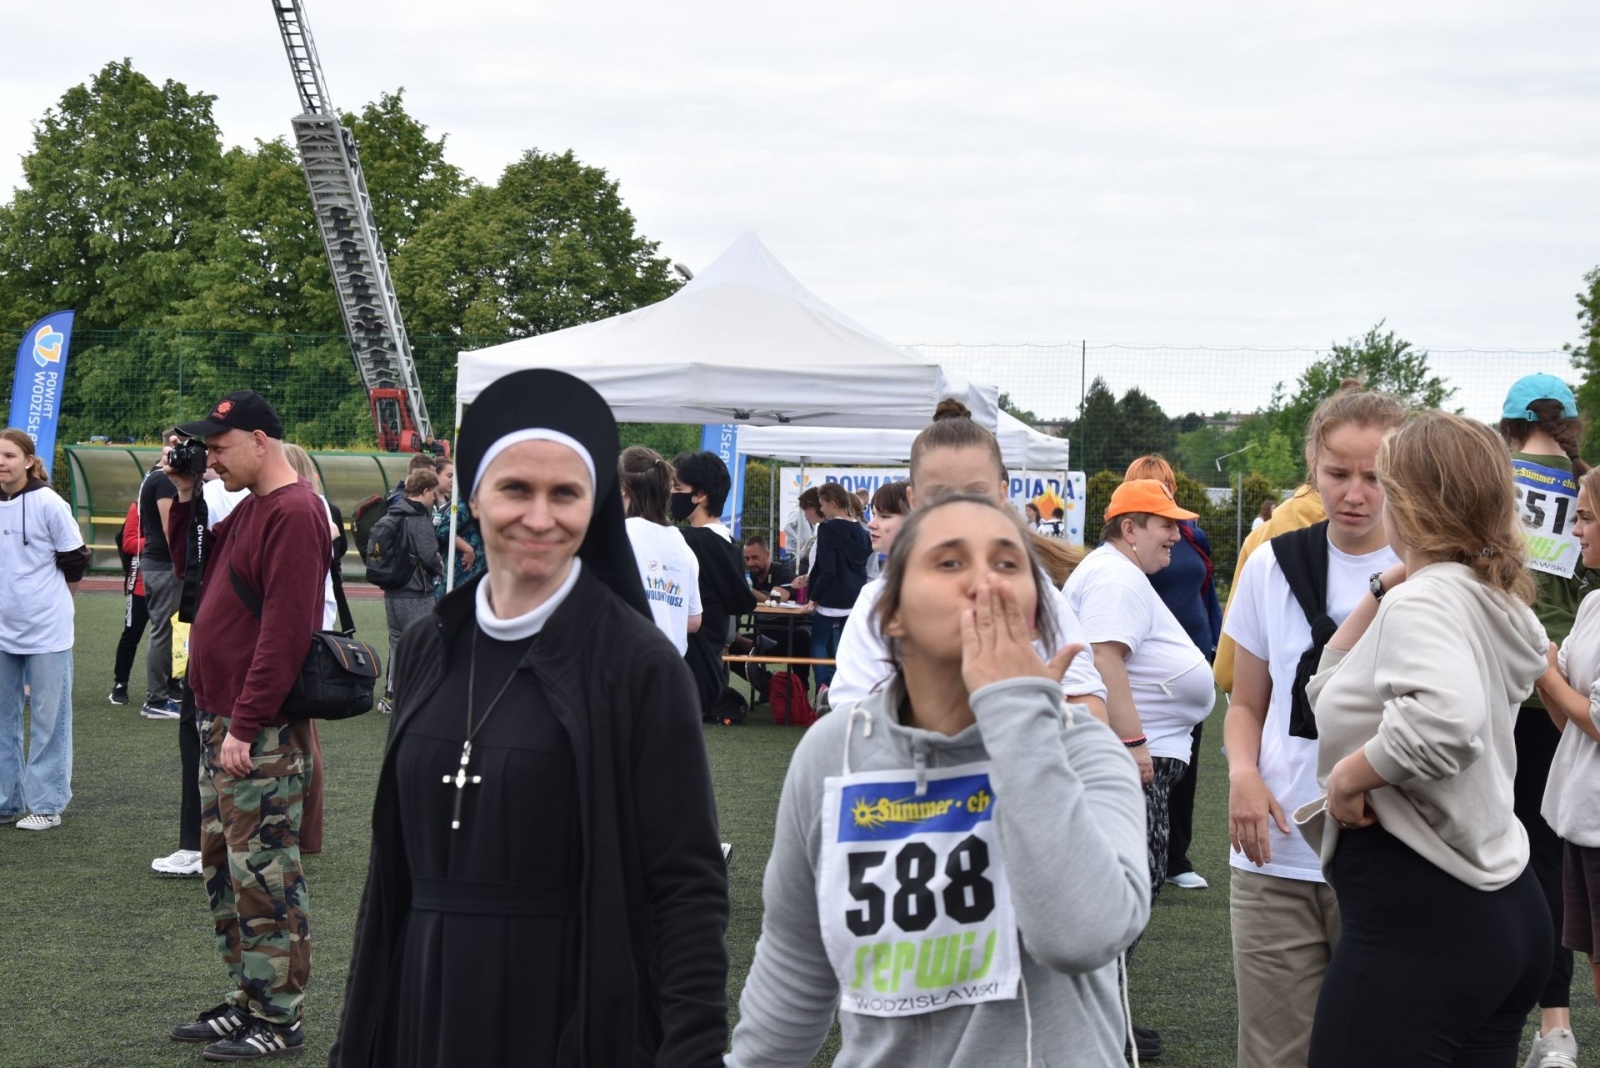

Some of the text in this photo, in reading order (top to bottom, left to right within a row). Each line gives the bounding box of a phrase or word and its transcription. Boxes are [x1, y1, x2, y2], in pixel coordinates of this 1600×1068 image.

[27, 371, 46, 446] WODZISŁA
[43, 371, 58, 419] POWIAT
[1010, 477, 1075, 499] PIADA
[1531, 560, 1567, 573] AWSKI
[877, 789, 991, 821] Summer ch
[845, 834, 995, 937] 588
[855, 982, 999, 1012] WODZISŁAWSKI
